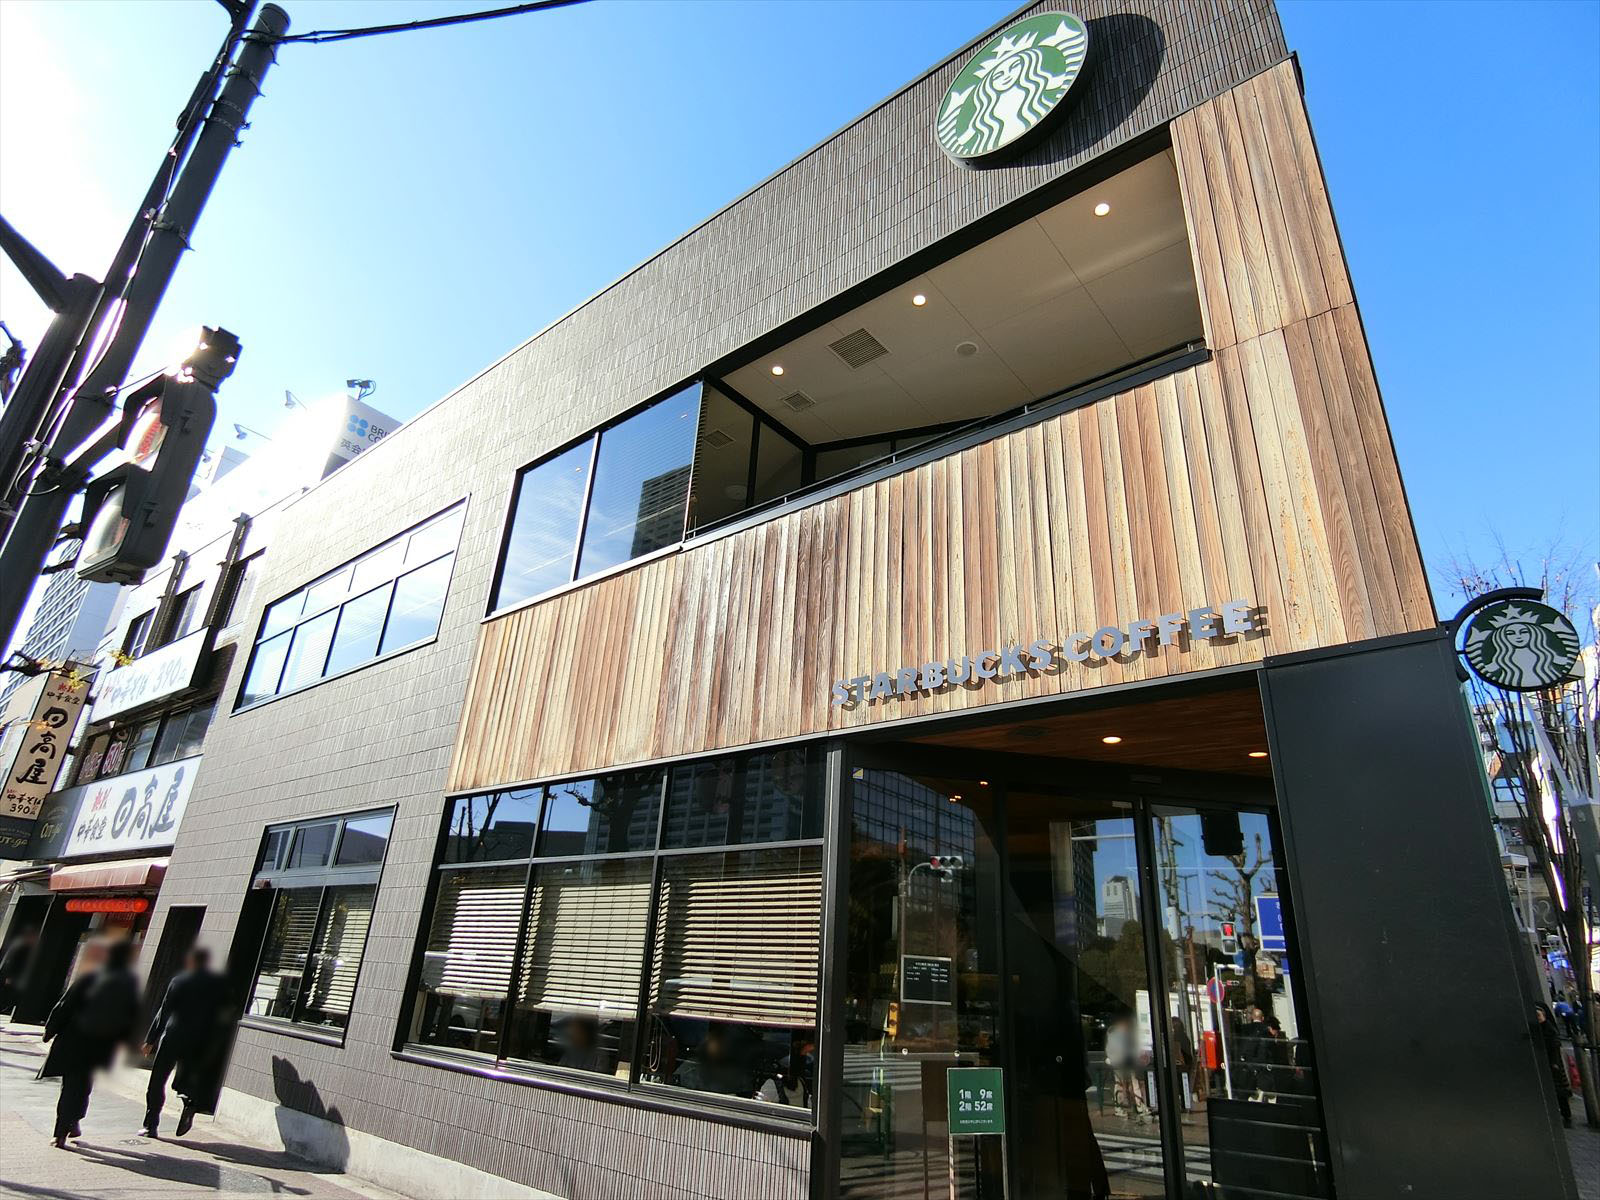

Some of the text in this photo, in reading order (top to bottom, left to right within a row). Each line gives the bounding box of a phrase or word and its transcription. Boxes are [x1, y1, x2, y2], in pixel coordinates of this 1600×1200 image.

[371, 425, 390, 438] BRI
[831, 599, 1252, 705] STARBUCKS COFFEE
[15, 706, 69, 785] 日高屋
[111, 766, 185, 840] 日高屋
